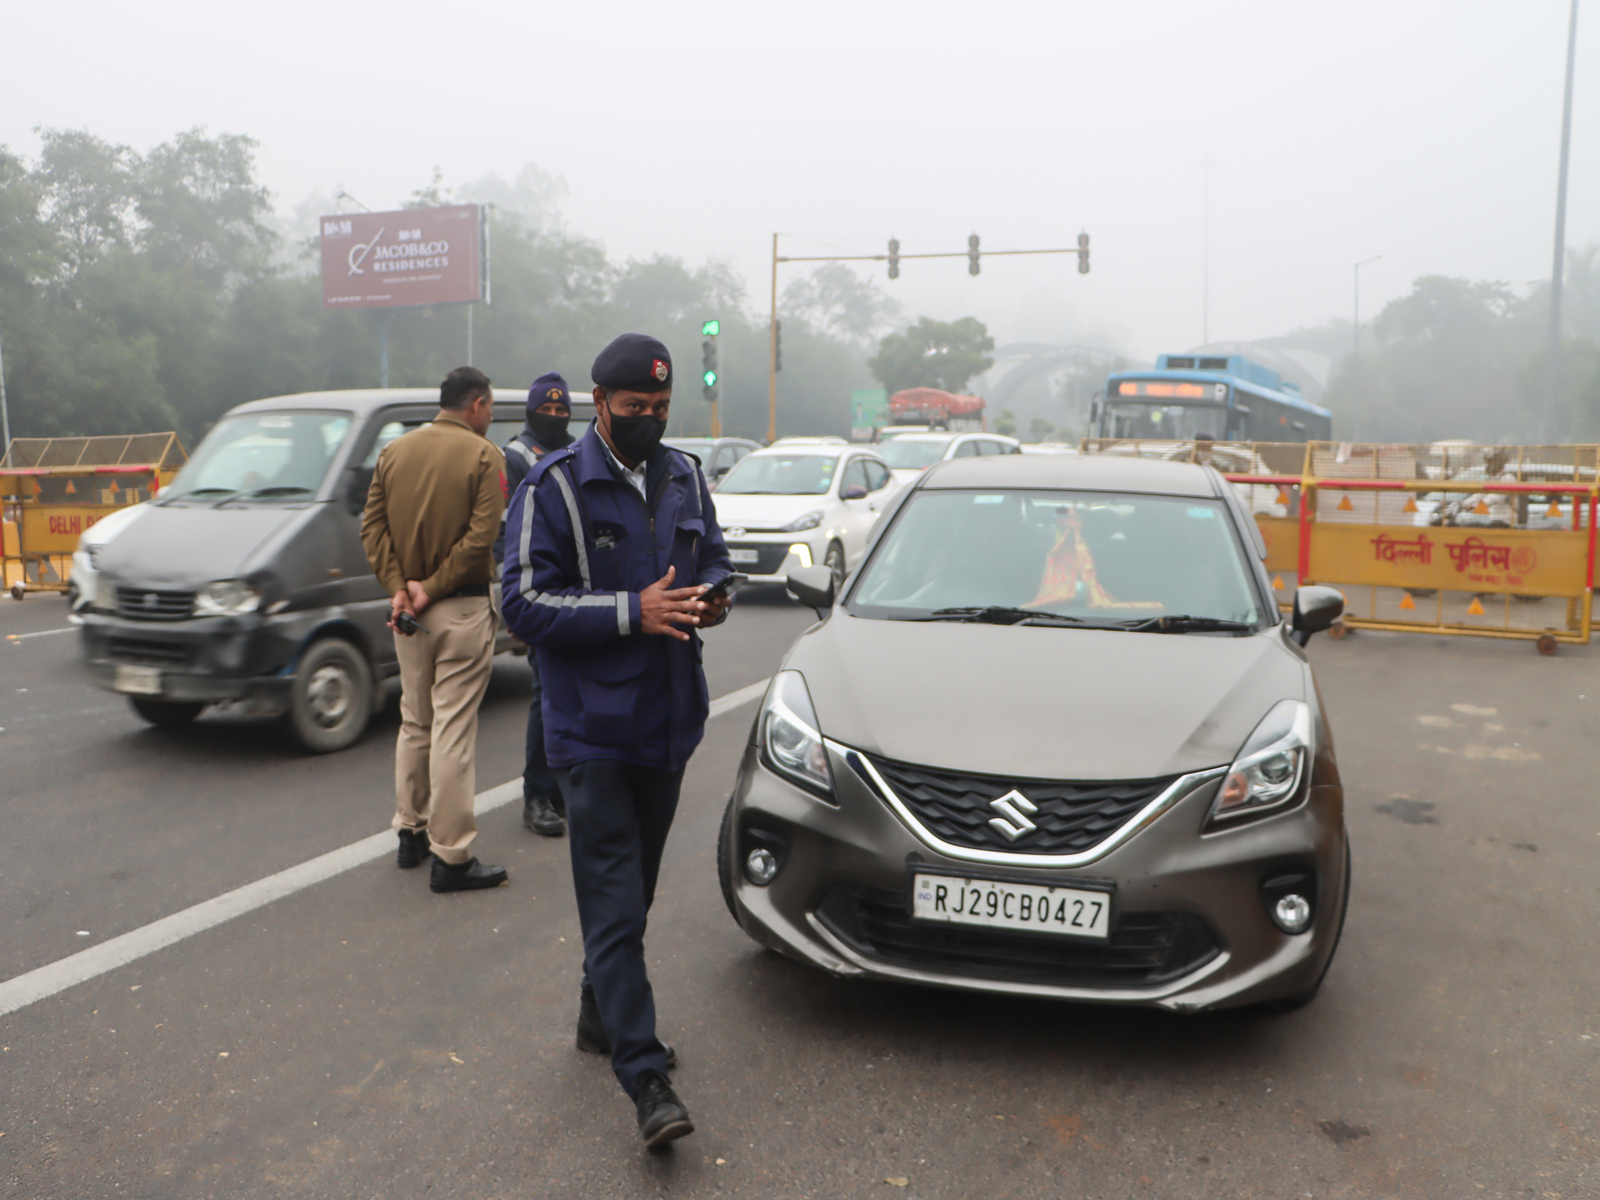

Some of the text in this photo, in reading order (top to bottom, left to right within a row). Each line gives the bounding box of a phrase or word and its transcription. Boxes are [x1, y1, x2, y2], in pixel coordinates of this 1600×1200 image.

[373, 241, 449, 260] JACOB&CO
[373, 256, 449, 272] RESIDENCES
[49, 515, 82, 534] DELHI
[1370, 533, 1434, 565] दिल्ली
[1445, 536, 1512, 572] पुलिस
[918, 892, 932, 901] IND
[935, 884, 1104, 928] RJ29CB0427
